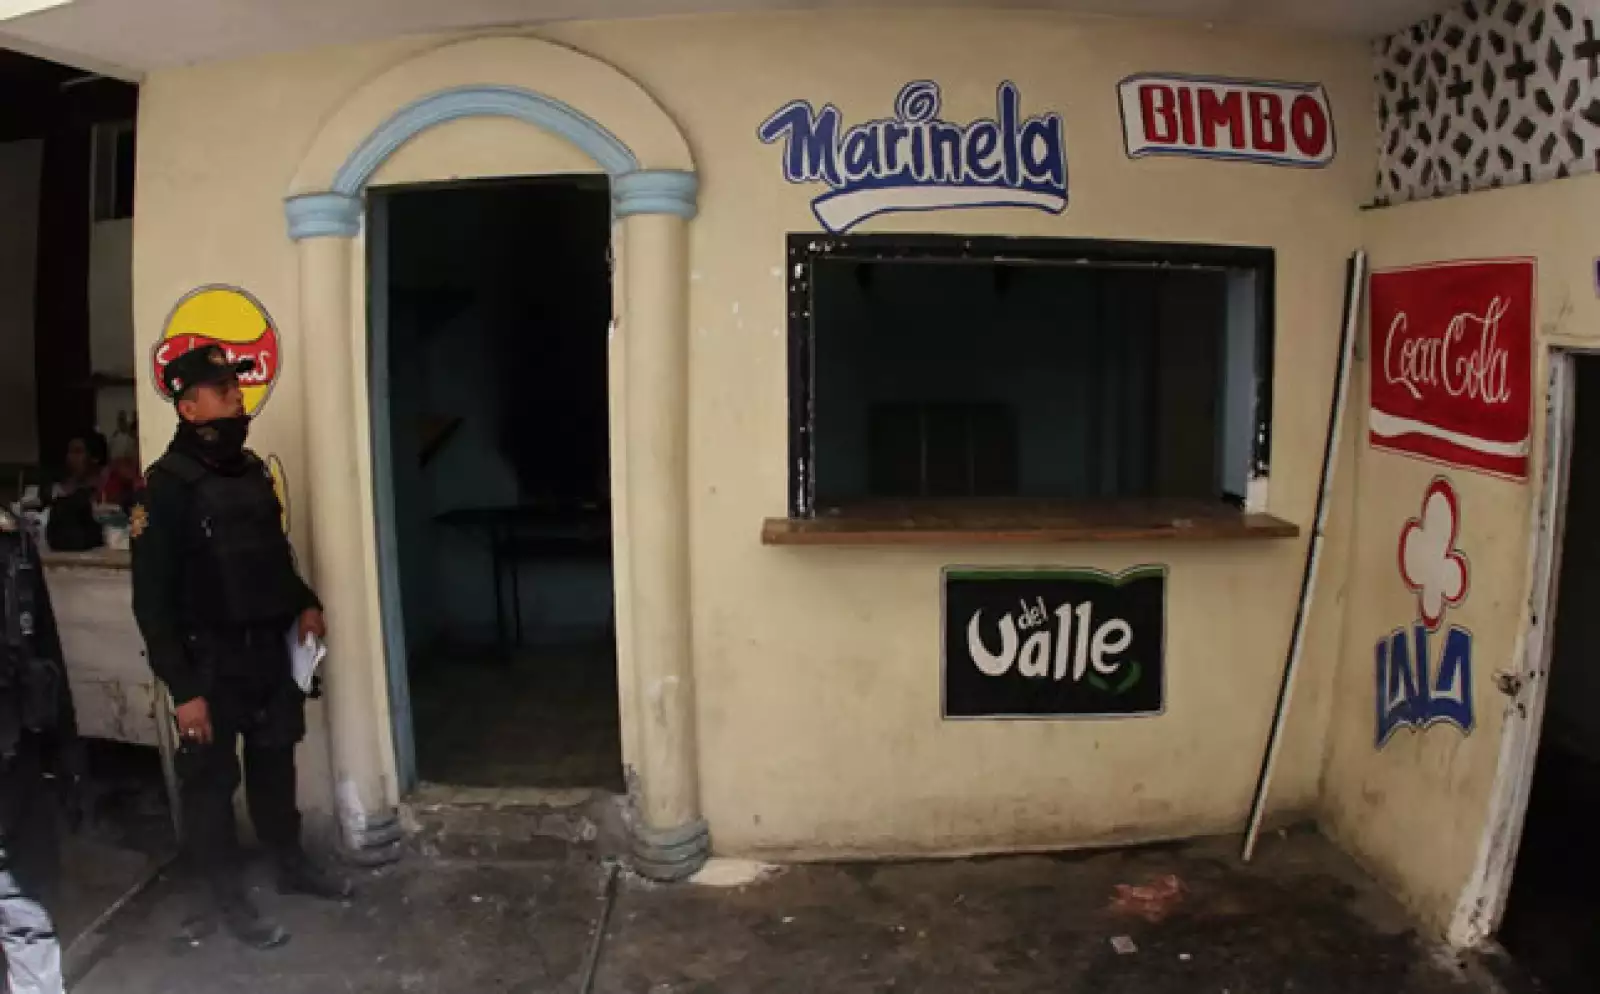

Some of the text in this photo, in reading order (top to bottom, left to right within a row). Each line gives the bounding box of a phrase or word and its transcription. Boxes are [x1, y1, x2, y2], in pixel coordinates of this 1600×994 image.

[758, 80, 1068, 189] Marinela
[1139, 84, 1327, 157] BIMBO
[967, 601, 1133, 682] Valle
[1018, 596, 1049, 630] del
